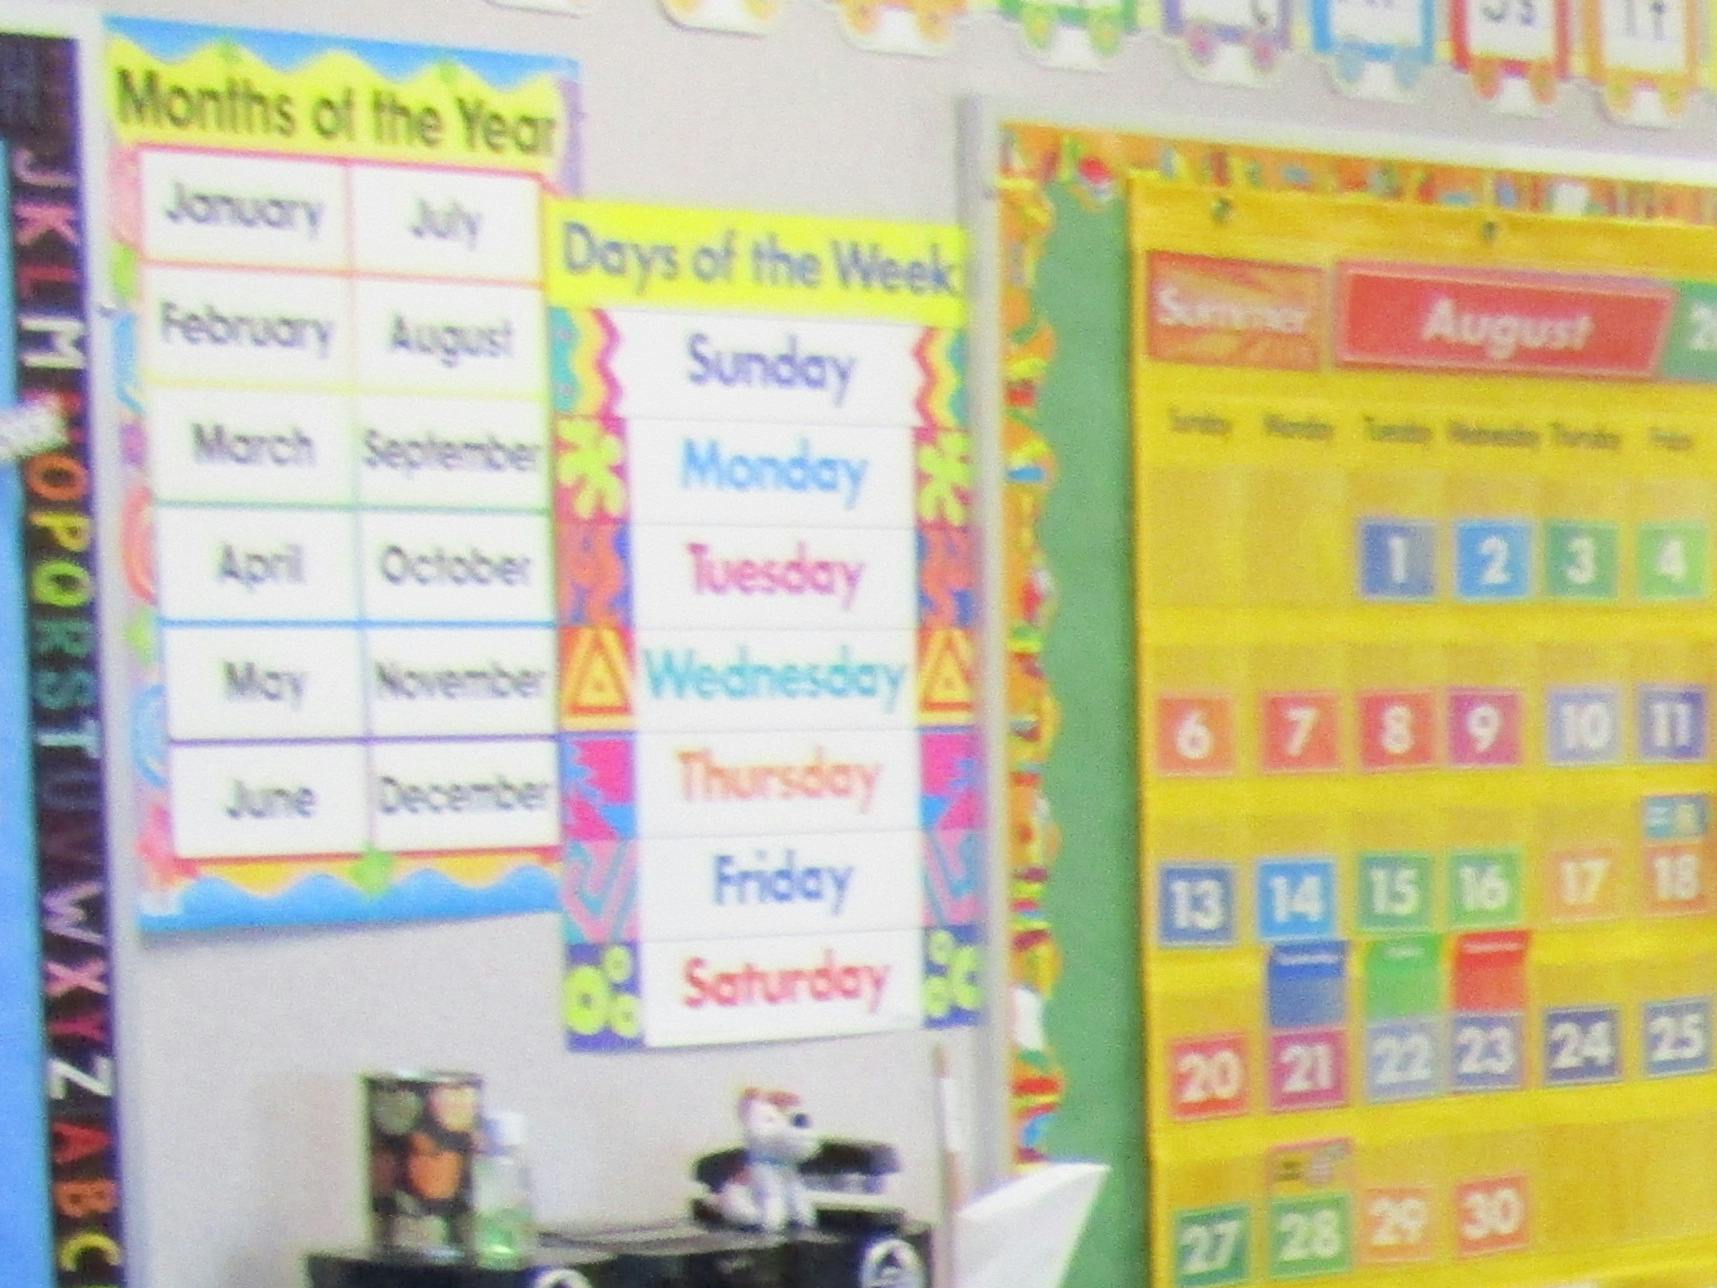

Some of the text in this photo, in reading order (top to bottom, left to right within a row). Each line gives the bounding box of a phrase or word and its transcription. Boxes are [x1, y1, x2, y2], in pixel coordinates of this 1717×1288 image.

[118, 67, 296, 138] Months
[311, 85, 355, 142] of
[370, 89, 443, 148] the
[457, 96, 557, 155] Year
[164, 182, 324, 240] January
[411, 197, 481, 249] July
[564, 221, 957, 297] Days of the Week
[161, 300, 334, 358] February
[390, 310, 512, 367] August
[1420, 293, 1594, 361] August
[687, 333, 856, 408] Sunday
[193, 422, 316, 467] March
[364, 428, 541, 480] September
[681, 436, 870, 511] Monday
[217, 542, 303, 592] April
[380, 544, 531, 585] October
[686, 541, 864, 611] Tuesday
[1388, 535, 1407, 585] 1
[1479, 536, 1509, 587] 2
[1566, 536, 1595, 586] 3
[1656, 536, 1687, 584] 4
[223, 660, 305, 709] May
[375, 660, 546, 699] November
[643, 644, 907, 714] Wednesday
[1176, 710, 1212, 760] 6
[1287, 706, 1319, 757] 7
[1380, 706, 1412, 755] 8
[1466, 705, 1500, 752] 9
[1560, 700, 1612, 751] 10
[1651, 700, 1687, 748] 11
[226, 778, 317, 818] June
[379, 774, 551, 814] December
[676, 746, 881, 814] Thursday
[714, 849, 854, 916] Friday
[1170, 880, 1222, 932] 13
[1268, 874, 1322, 924] 14
[1369, 866, 1420, 916] 15
[1458, 865, 1509, 912] 16
[1560, 859, 1609, 906] 17
[1654, 855, 1698, 901] 18
[684, 948, 891, 1014] Saturday
[1176, 1048, 1243, 1101] 20
[1280, 1043, 1335, 1096] 21
[1372, 1034, 1432, 1085] 22
[1456, 1027, 1516, 1079] 23
[1550, 1021, 1614, 1069] 24
[1649, 1014, 1706, 1062] 25
[1180, 1188, 1521, 1273] 27 28 29 30
